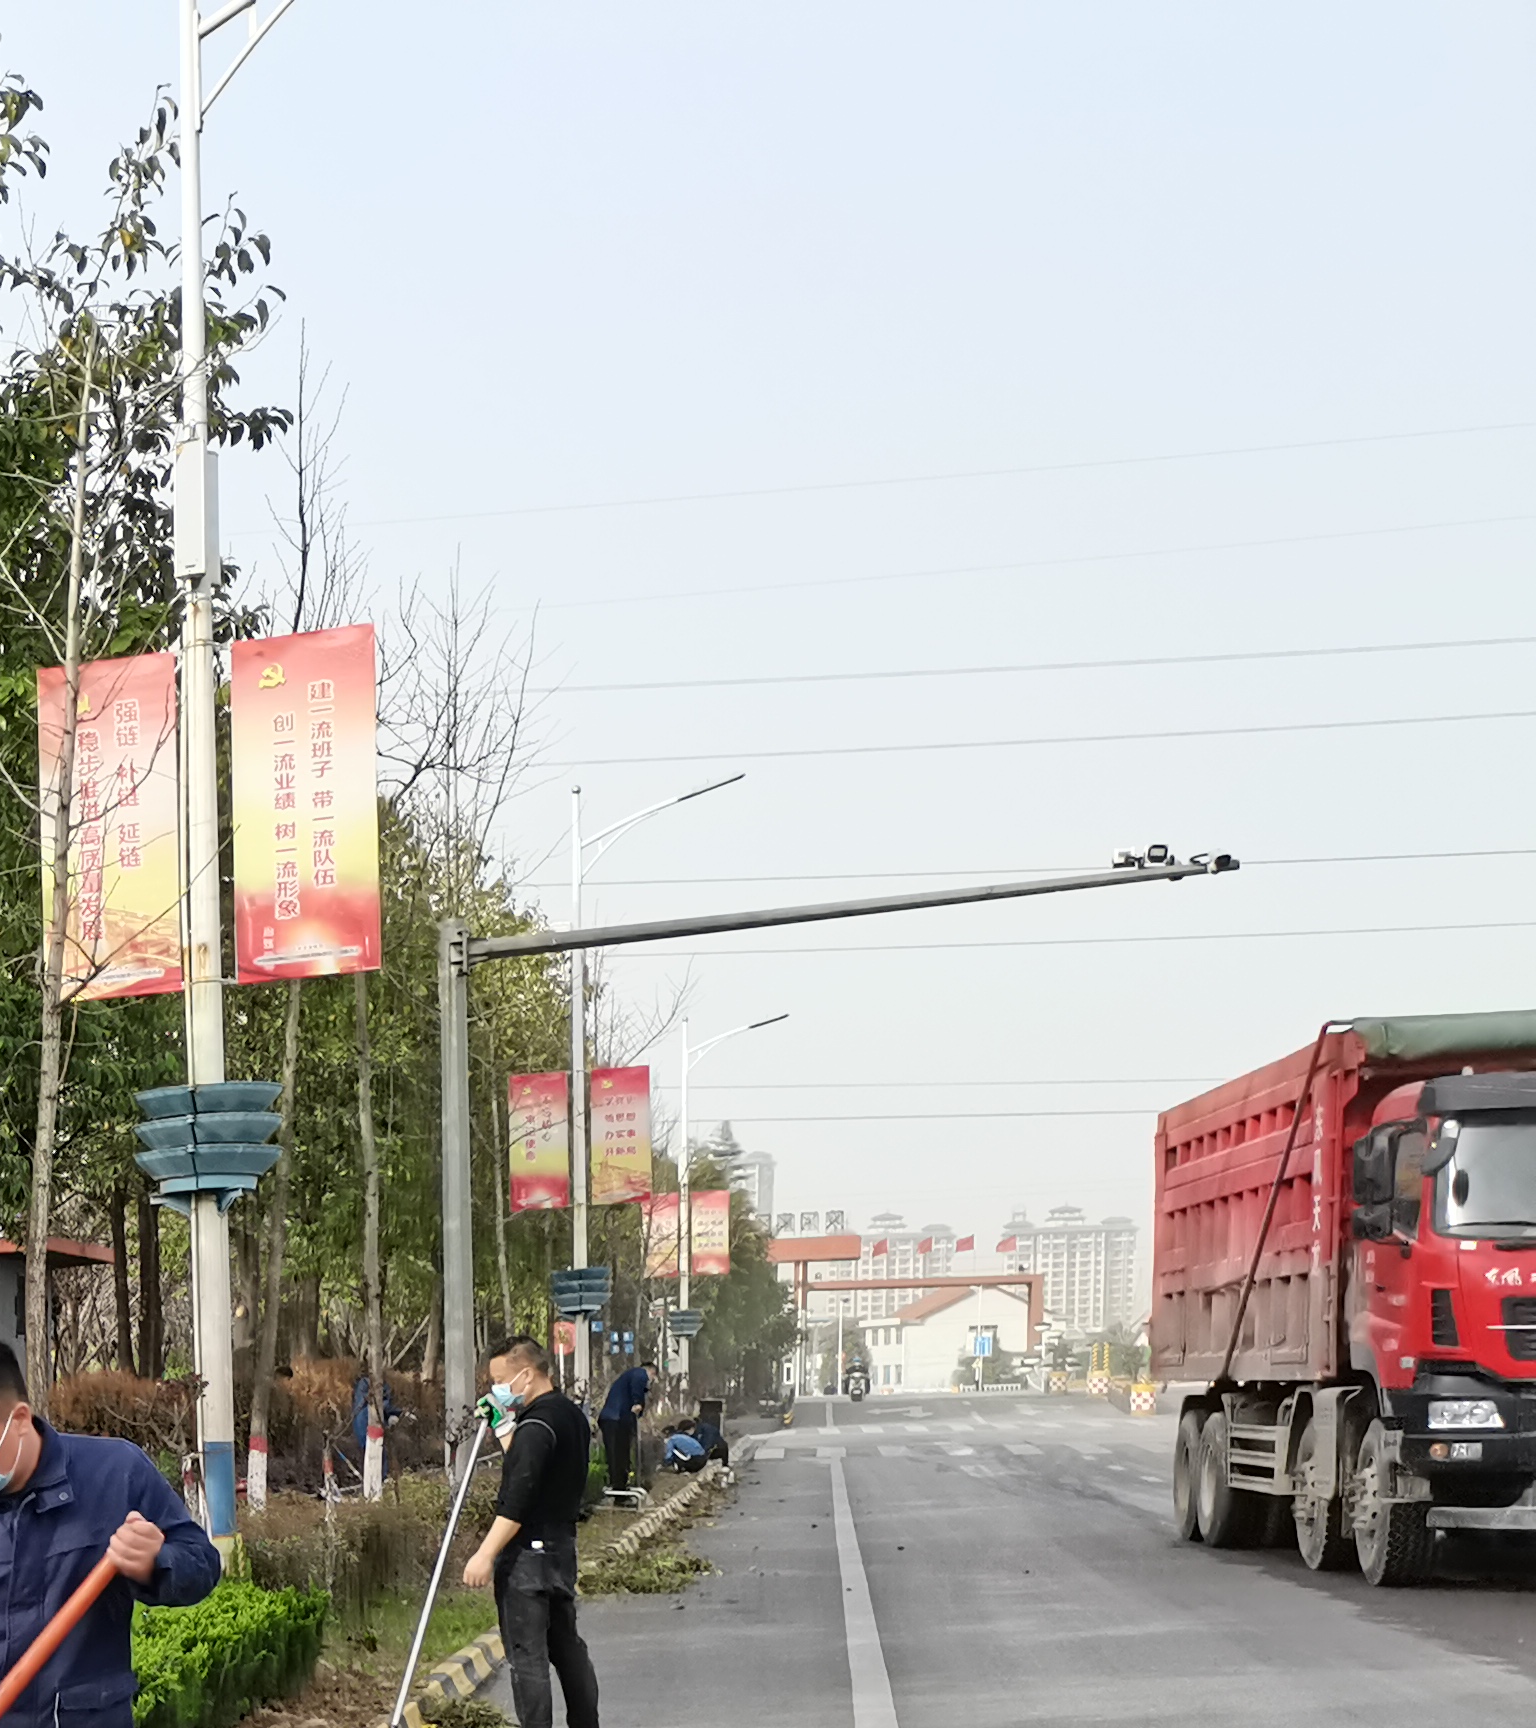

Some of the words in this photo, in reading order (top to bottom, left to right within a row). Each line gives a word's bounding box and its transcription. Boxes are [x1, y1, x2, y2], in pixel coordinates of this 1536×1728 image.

[116, 702, 138, 746] 强链
[273, 713, 296, 810] 创一流业绩
[310, 682, 333, 778] 建一流班子
[119, 823, 141, 868] 延链
[275, 821, 298, 918] 树一流形象
[312, 790, 335, 887] 带一流队伍
